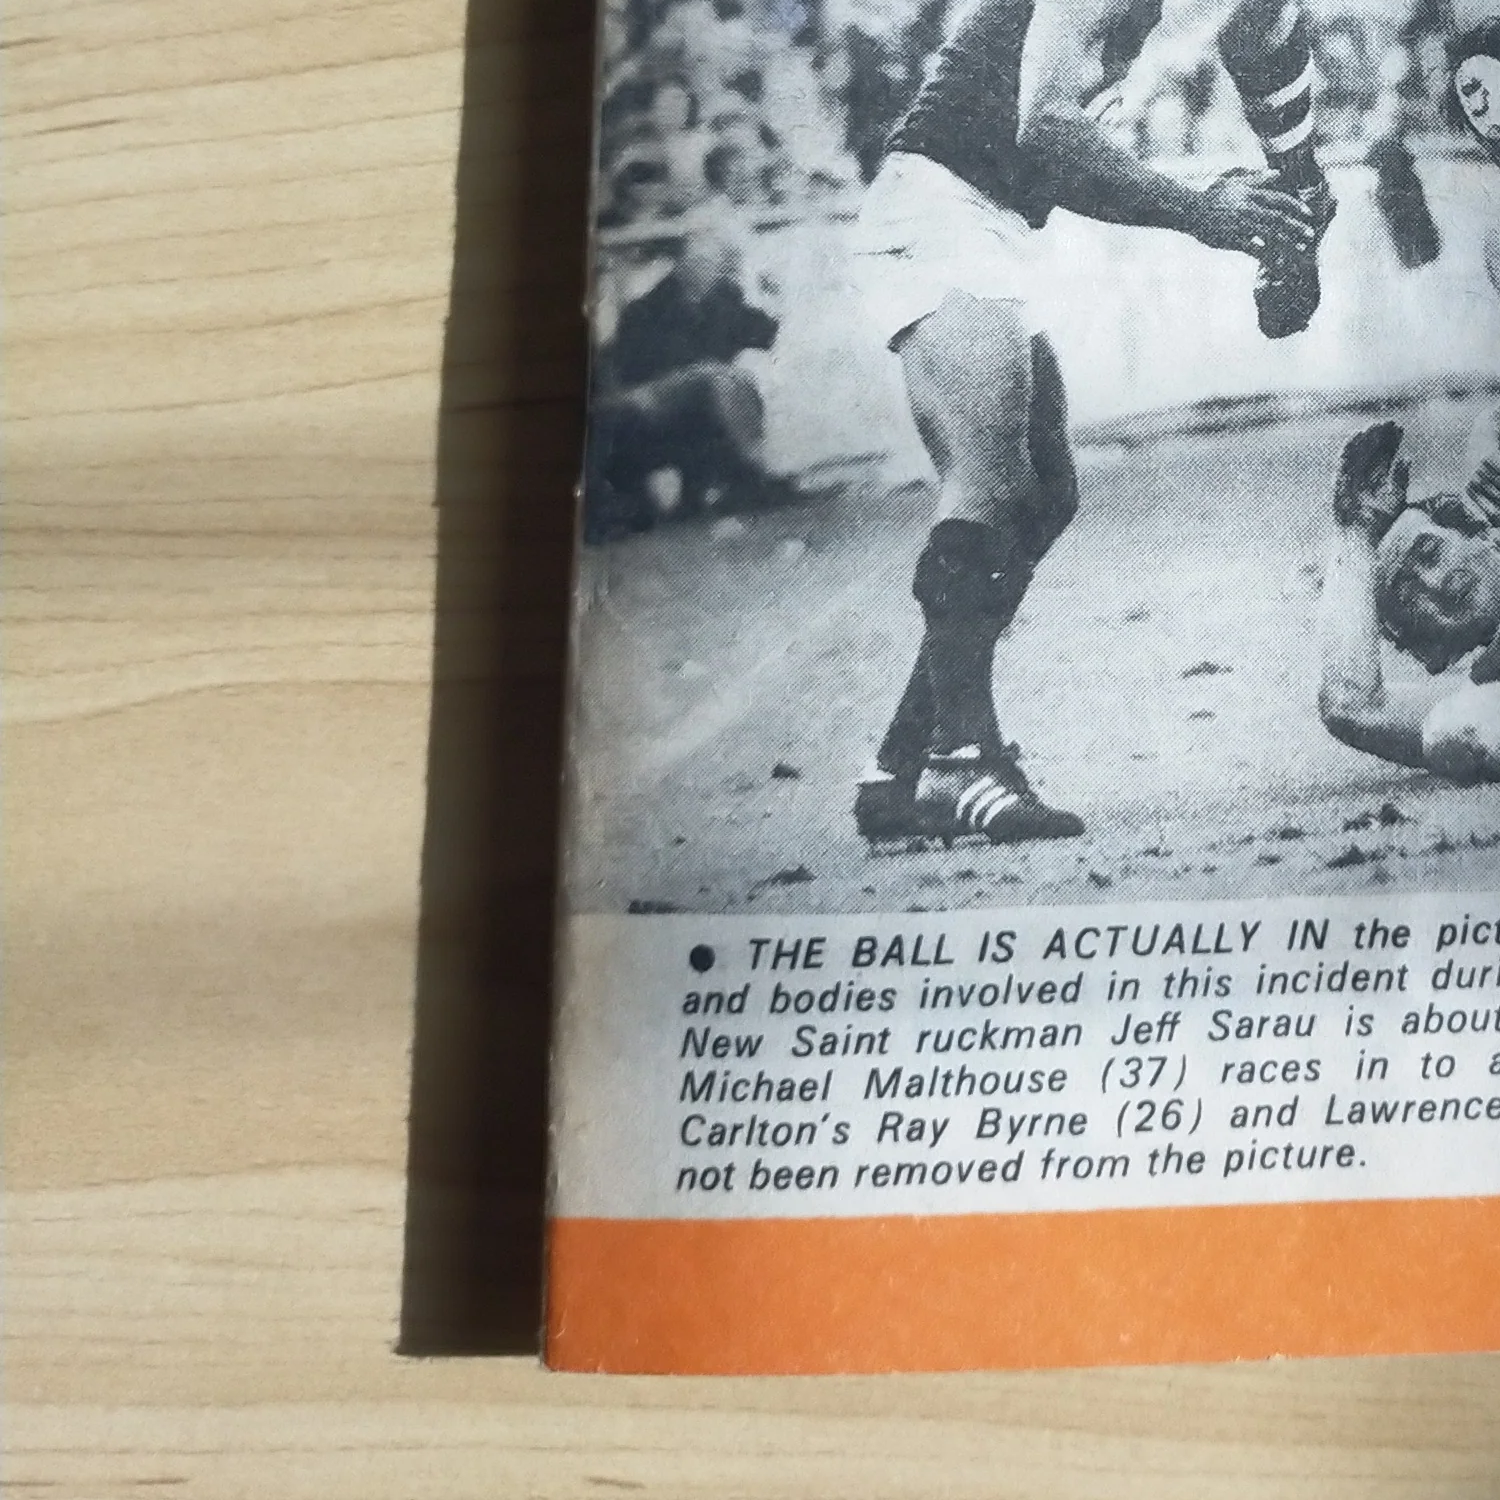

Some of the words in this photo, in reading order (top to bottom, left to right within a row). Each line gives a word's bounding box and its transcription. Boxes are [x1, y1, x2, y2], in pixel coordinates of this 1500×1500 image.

[748, 936, 827, 971] THE
[850, 932, 955, 969] BALL
[977, 929, 1018, 965] IS
[1041, 919, 1263, 961] ACTUALLY
[1286, 917, 1331, 952] IN
[1353, 917, 1412, 951] the
[680, 982, 752, 1017] and
[768, 980, 899, 1015] bodies
[918, 970, 1084, 1010] involved
[1106, 969, 1141, 1003] in
[1162, 965, 1233, 1000] this
[1255, 959, 1410, 996] incident
[678, 1026, 765, 1060] New
[790, 1024, 892, 1059] Saint
[914, 1018, 1083, 1055] ruckman
[1109, 1010, 1182, 1047] Jeff
[1206, 1008, 1318, 1043] Sarau
[1344, 1004, 1375, 1038] is
[678, 1068, 834, 1104] Michael
[862, 1064, 1069, 1101] Malthouse
[1100, 1053, 1187, 1095] (37)
[1219, 1058, 1322, 1085] races
[1354, 1048, 1390, 1082] in
[1420, 1051, 1457, 1081] to
[678, 1112, 852, 1148] Carlton's
[875, 1110, 951, 1149] Ray
[974, 1106, 1089, 1146] Byrne
[1116, 1097, 1203, 1139] (26)
[1229, 1094, 1300, 1130] and
[674, 1162, 737, 1194] not
[748, 1157, 840, 1192] been
[853, 1149, 1026, 1189] removed
[1040, 1147, 1131, 1181] from
[1147, 1142, 1207, 1179] the
[1222, 1138, 1367, 1180] picture.
